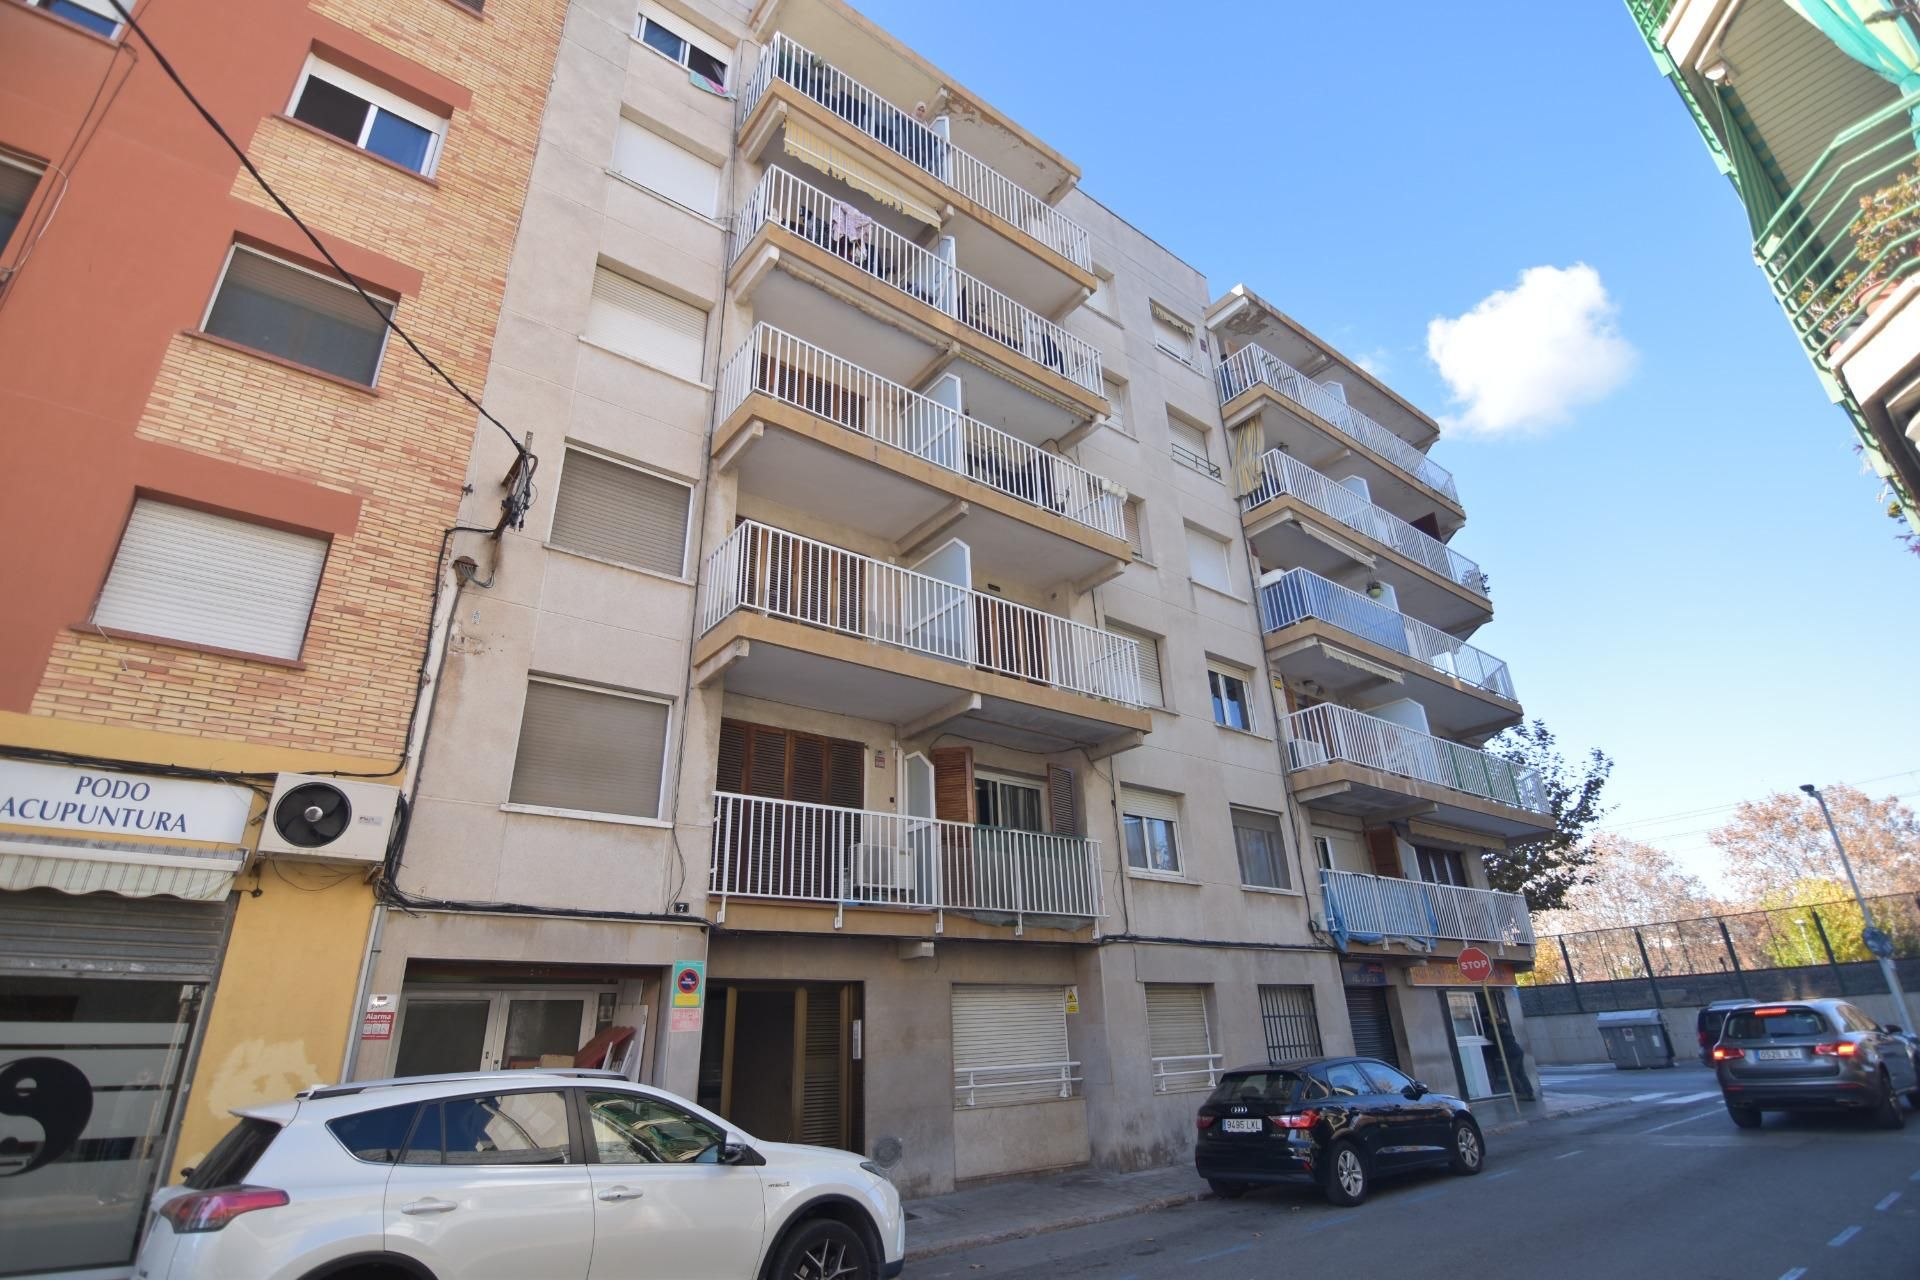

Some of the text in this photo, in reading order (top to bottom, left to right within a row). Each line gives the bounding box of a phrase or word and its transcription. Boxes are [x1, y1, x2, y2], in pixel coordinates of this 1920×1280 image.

[75, 775, 151, 801] PODO
[0, 797, 188, 833] ACUPUNTURA
[1461, 960, 1488, 971] STOP
